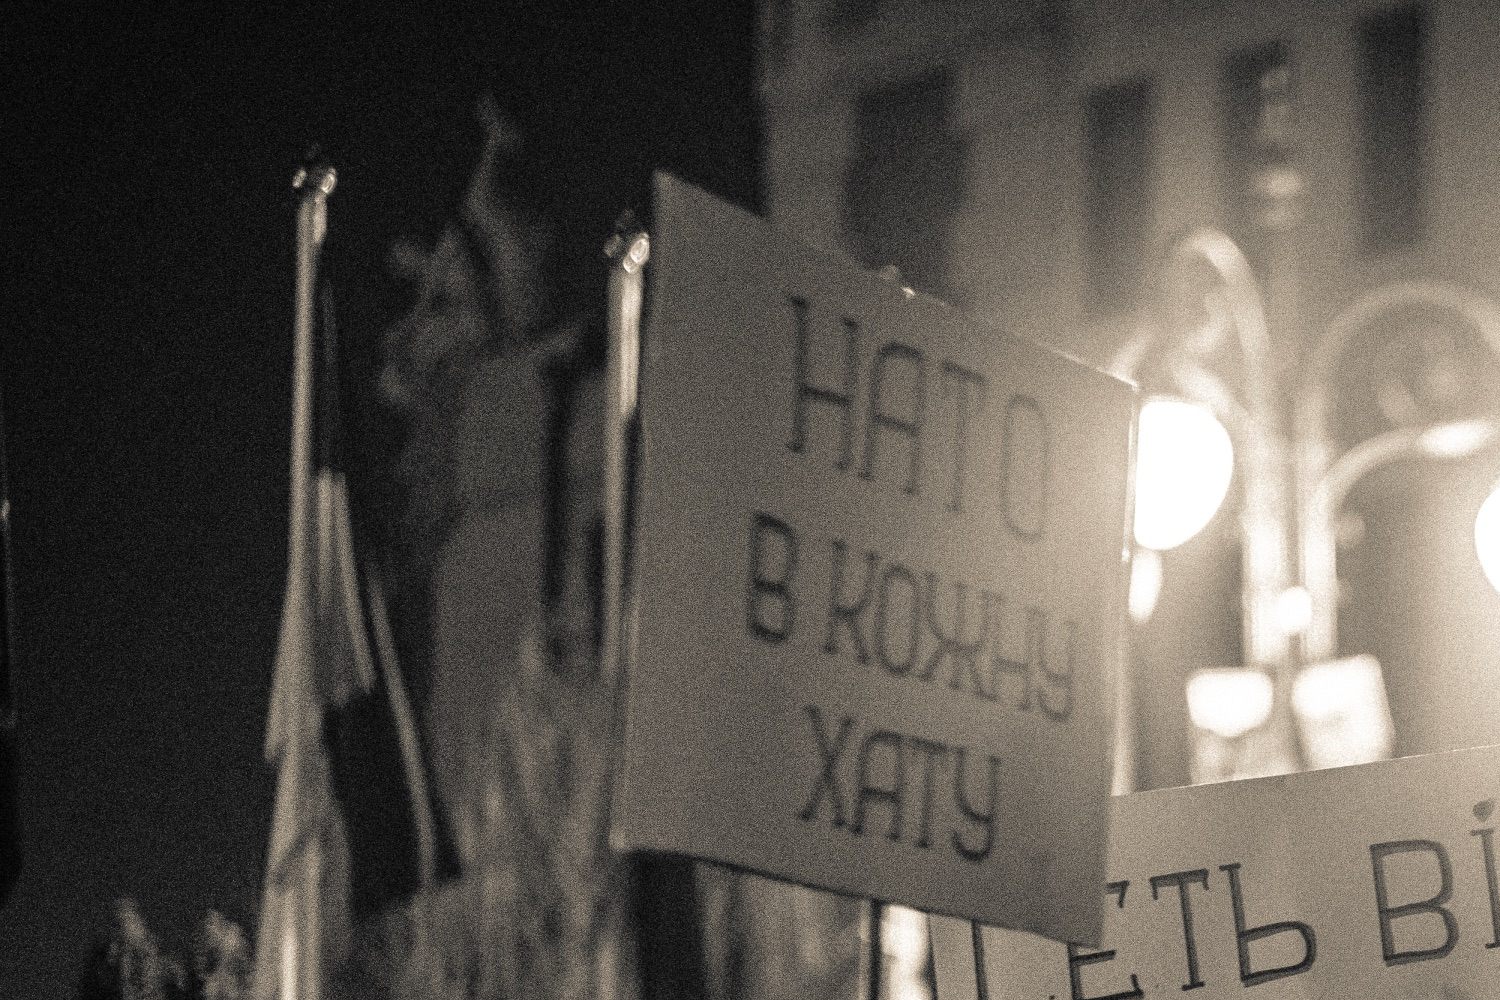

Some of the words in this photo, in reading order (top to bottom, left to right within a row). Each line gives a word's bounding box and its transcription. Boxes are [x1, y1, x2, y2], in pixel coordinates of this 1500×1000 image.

[786, 294, 1049, 541] НАТО
[745, 510, 798, 645] В
[822, 538, 1076, 723] КОЖНУ
[797, 704, 1000, 863] ХАТУ
